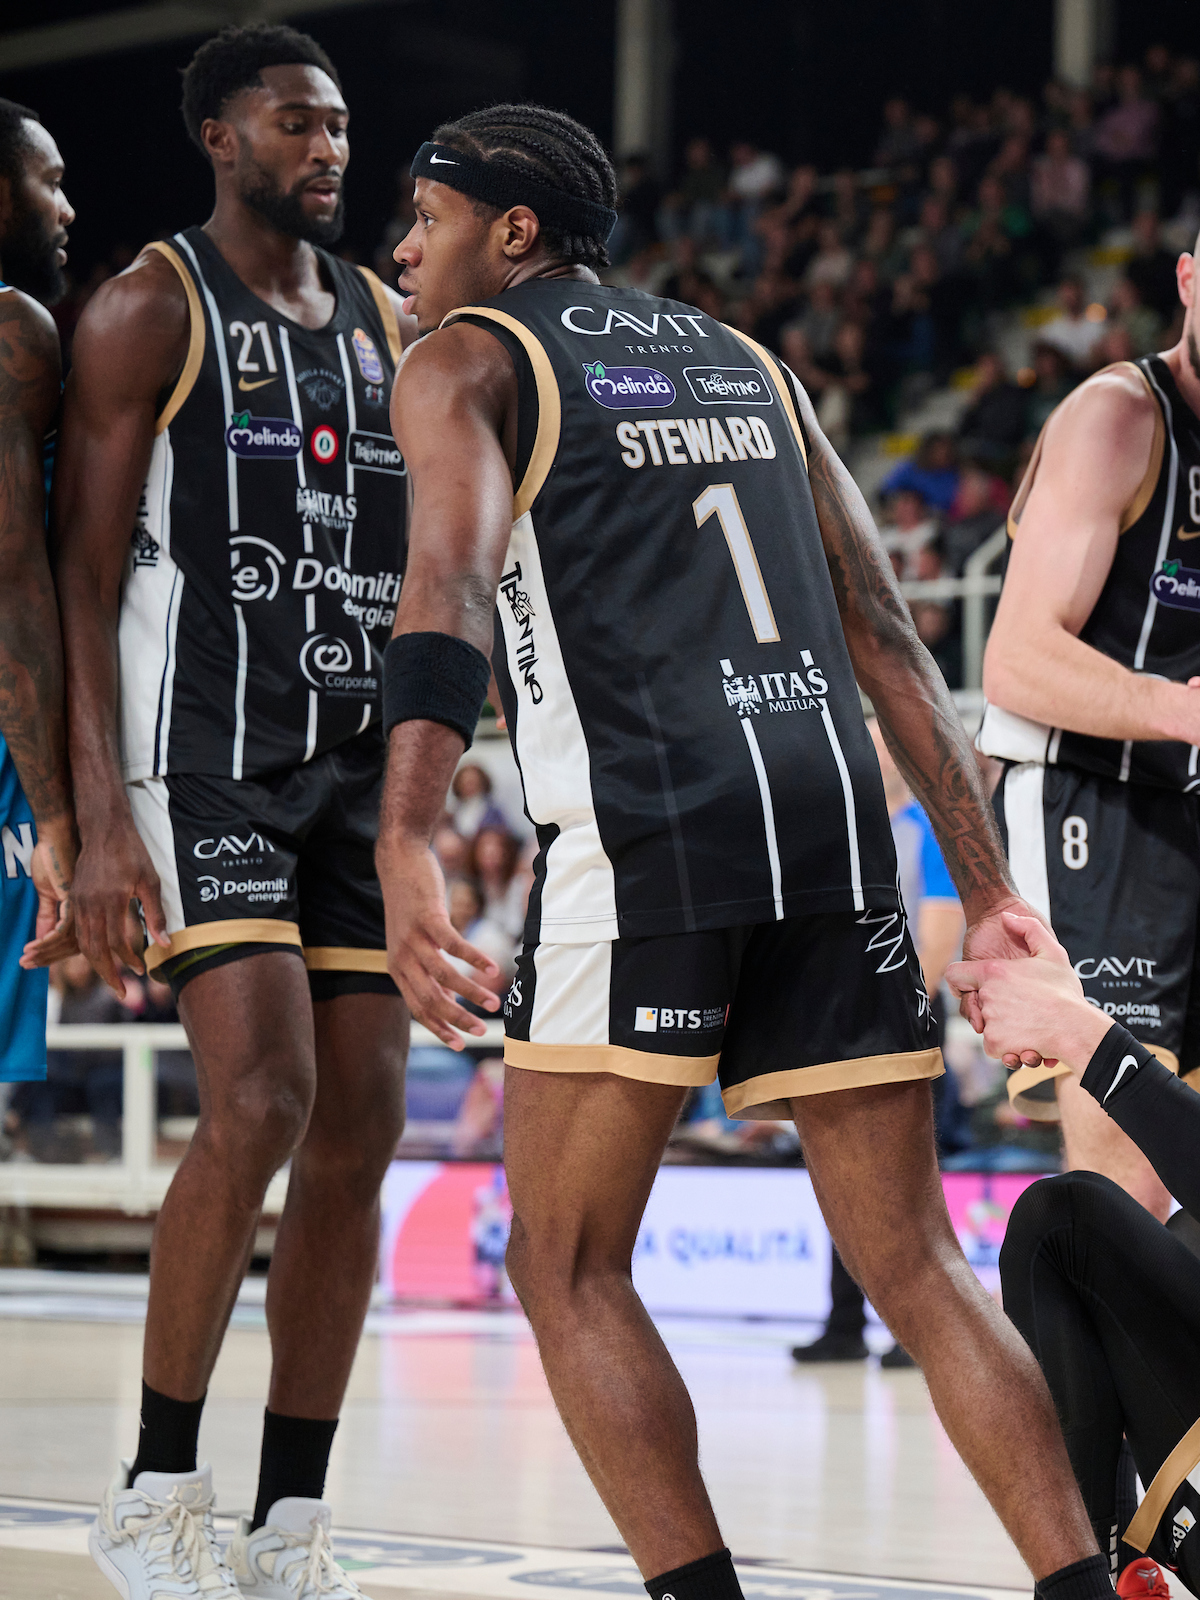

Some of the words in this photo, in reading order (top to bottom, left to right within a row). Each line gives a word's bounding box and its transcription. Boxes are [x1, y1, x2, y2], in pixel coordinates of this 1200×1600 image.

[560, 306, 710, 338] CAVIT
[229, 320, 278, 373] 21
[624, 344, 694, 354] TRENTO
[590, 375, 671, 396] Melinda
[695, 376, 761, 397] TRENTINO
[229, 426, 300, 447] Melinda
[615, 415, 777, 469] STEWARD
[353, 442, 402, 465] TRENTINO
[691, 481, 782, 644] 1
[499, 561, 544, 705] TRENTINO
[325, 673, 377, 690] Corporate
[758, 668, 829, 700] ITAS
[768, 698, 819, 713] MUTUA
[1, 822, 36, 879] N
[1062, 815, 1089, 870] 8
[223, 878, 288, 896] Dolomiti
[1074, 956, 1157, 980] CAVIT
[660, 1008, 702, 1029] BTS
